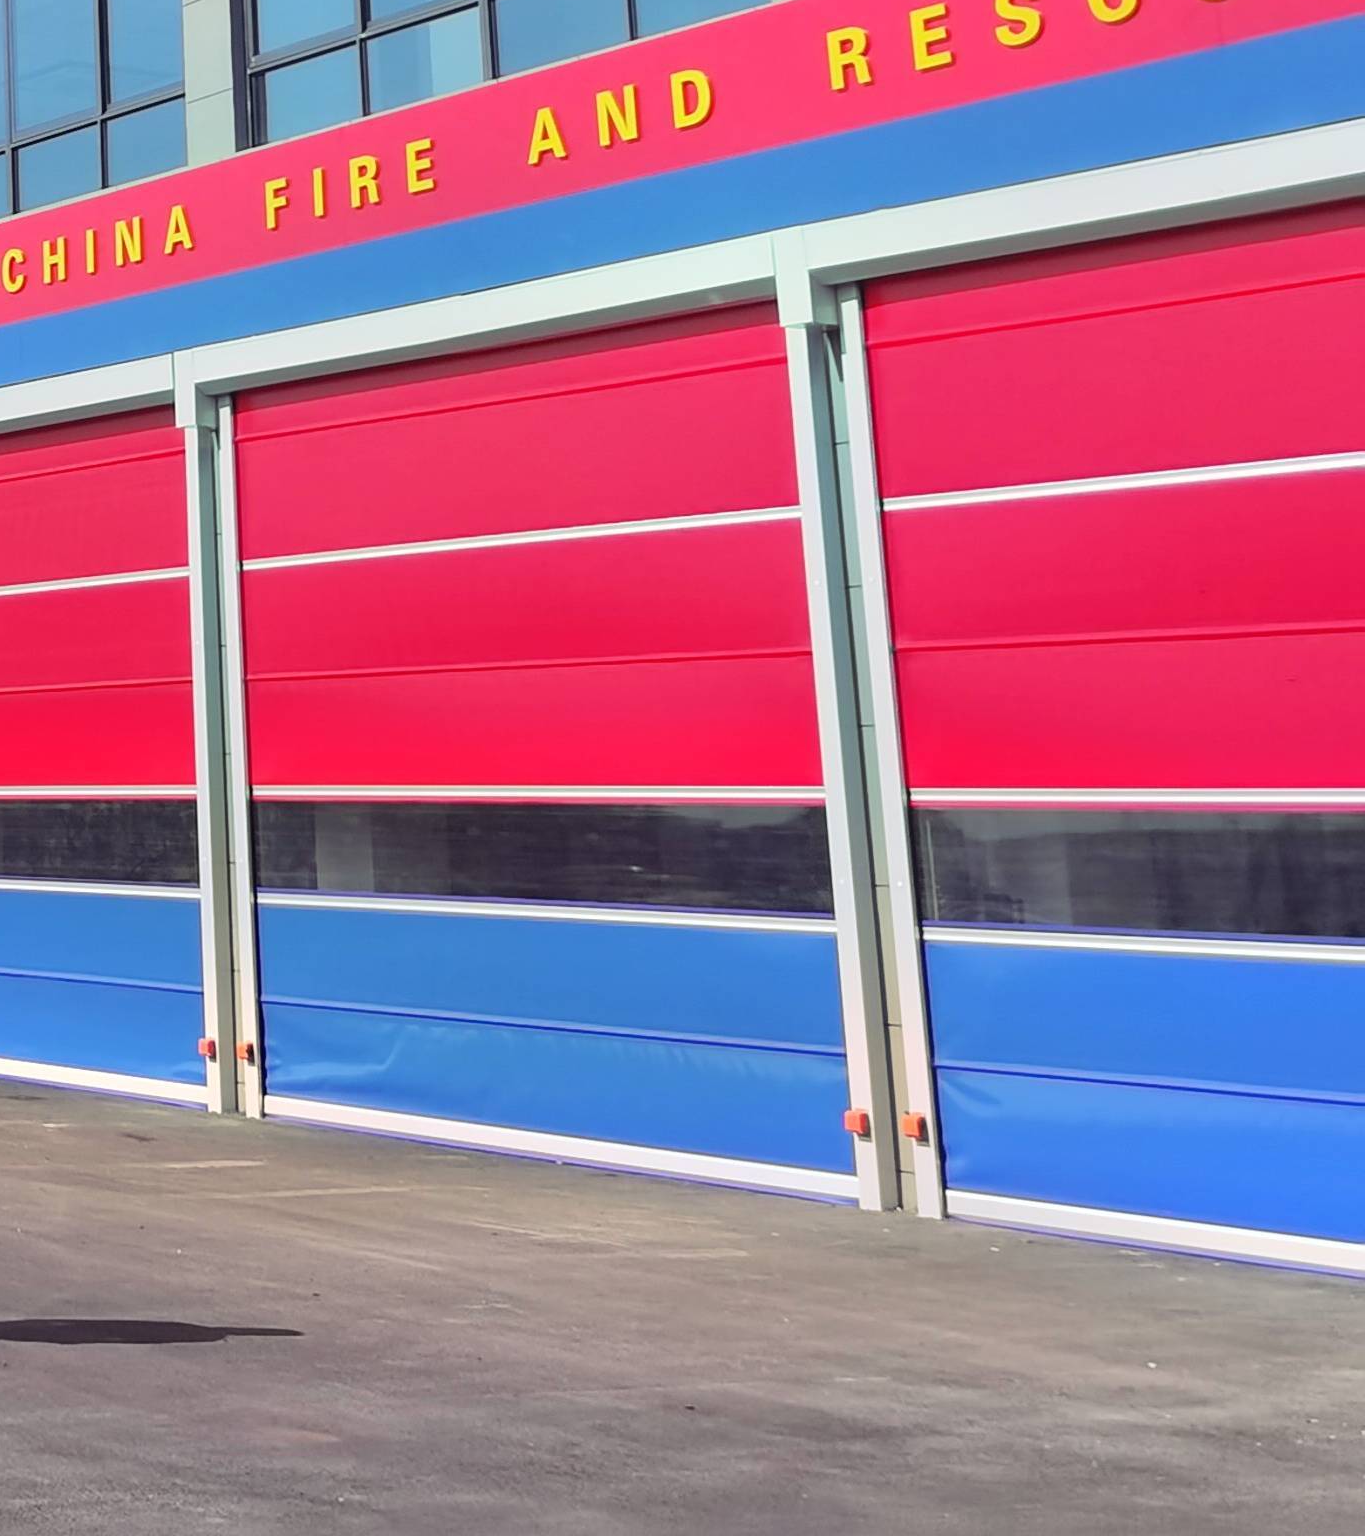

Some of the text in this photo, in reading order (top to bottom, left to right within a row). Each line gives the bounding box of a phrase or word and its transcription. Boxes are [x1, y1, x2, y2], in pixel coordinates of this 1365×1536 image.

[0, 204, 194, 294] CHINA
[264, 137, 437, 230] FIRE
[527, 68, 713, 166] AND
